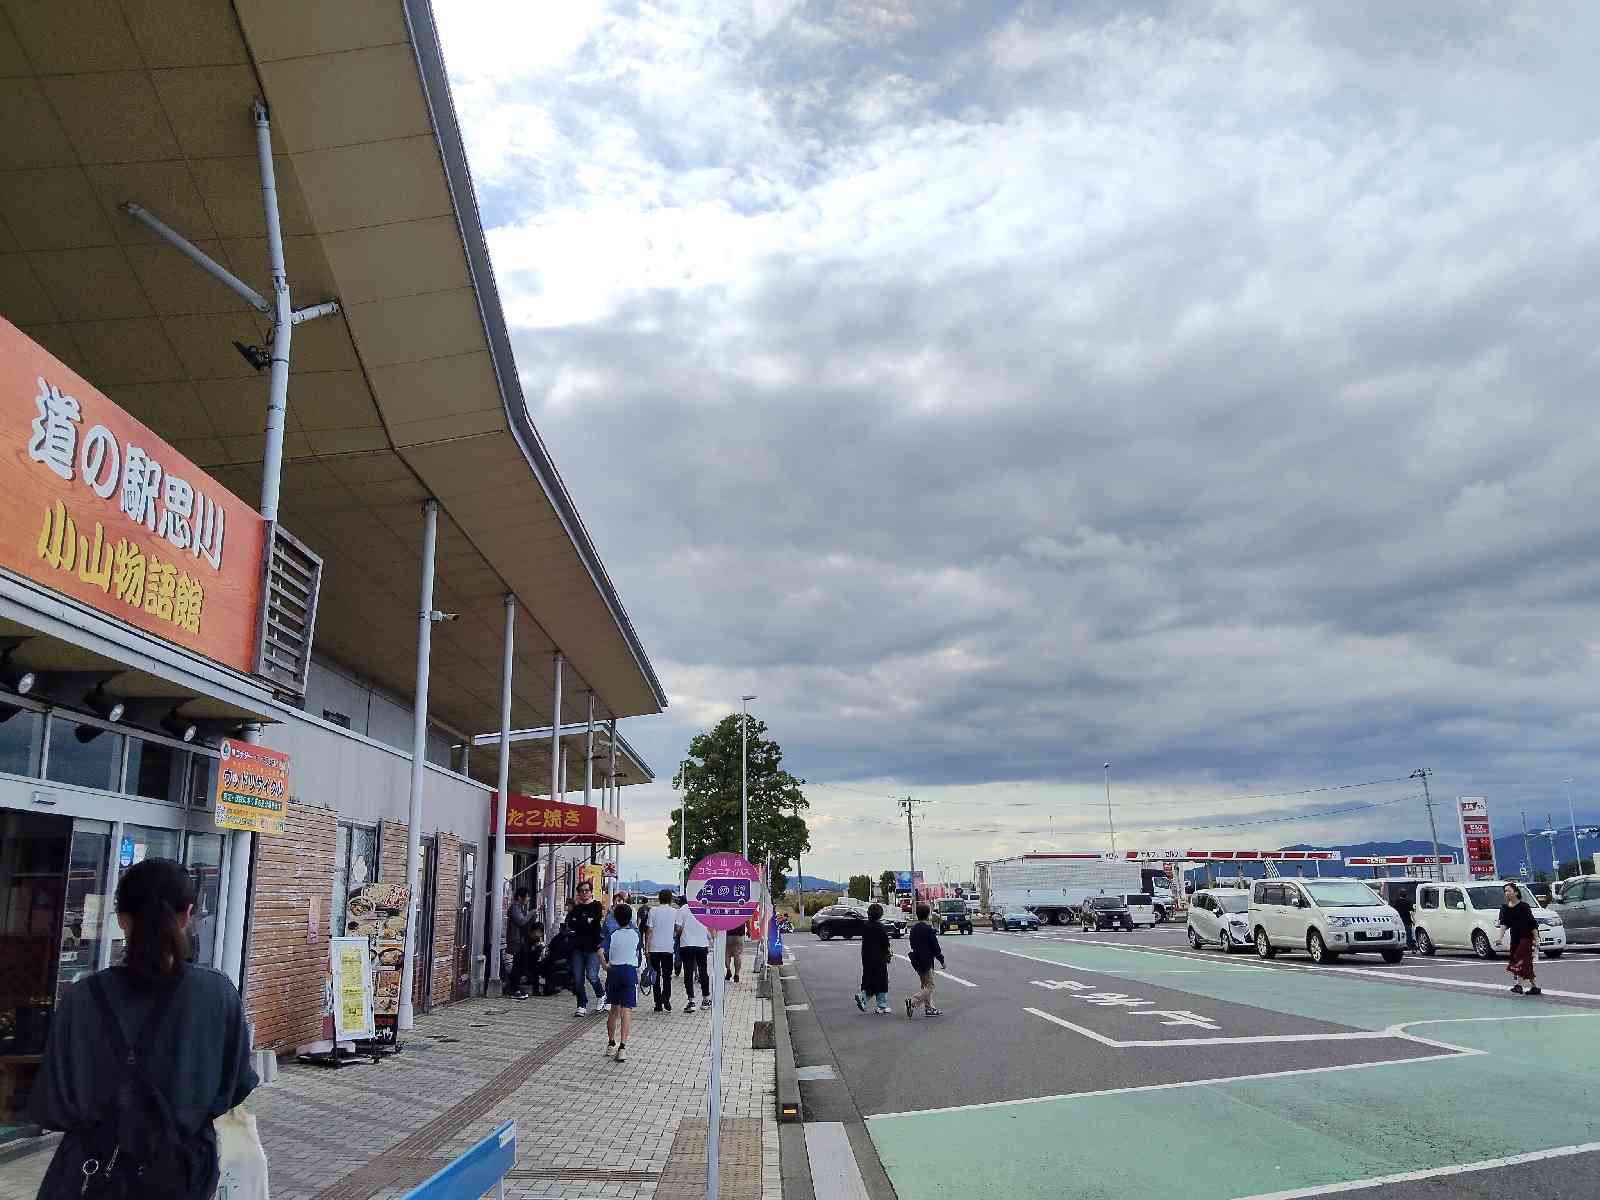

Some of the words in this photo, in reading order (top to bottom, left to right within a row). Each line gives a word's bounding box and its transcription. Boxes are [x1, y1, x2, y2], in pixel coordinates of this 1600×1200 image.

[27, 376, 226, 570] 道の駅思川
[38, 500, 205, 634] 小山物語館
[507, 808, 581, 828] たこ焼き
[697, 867, 752, 876] コミュニティバス
